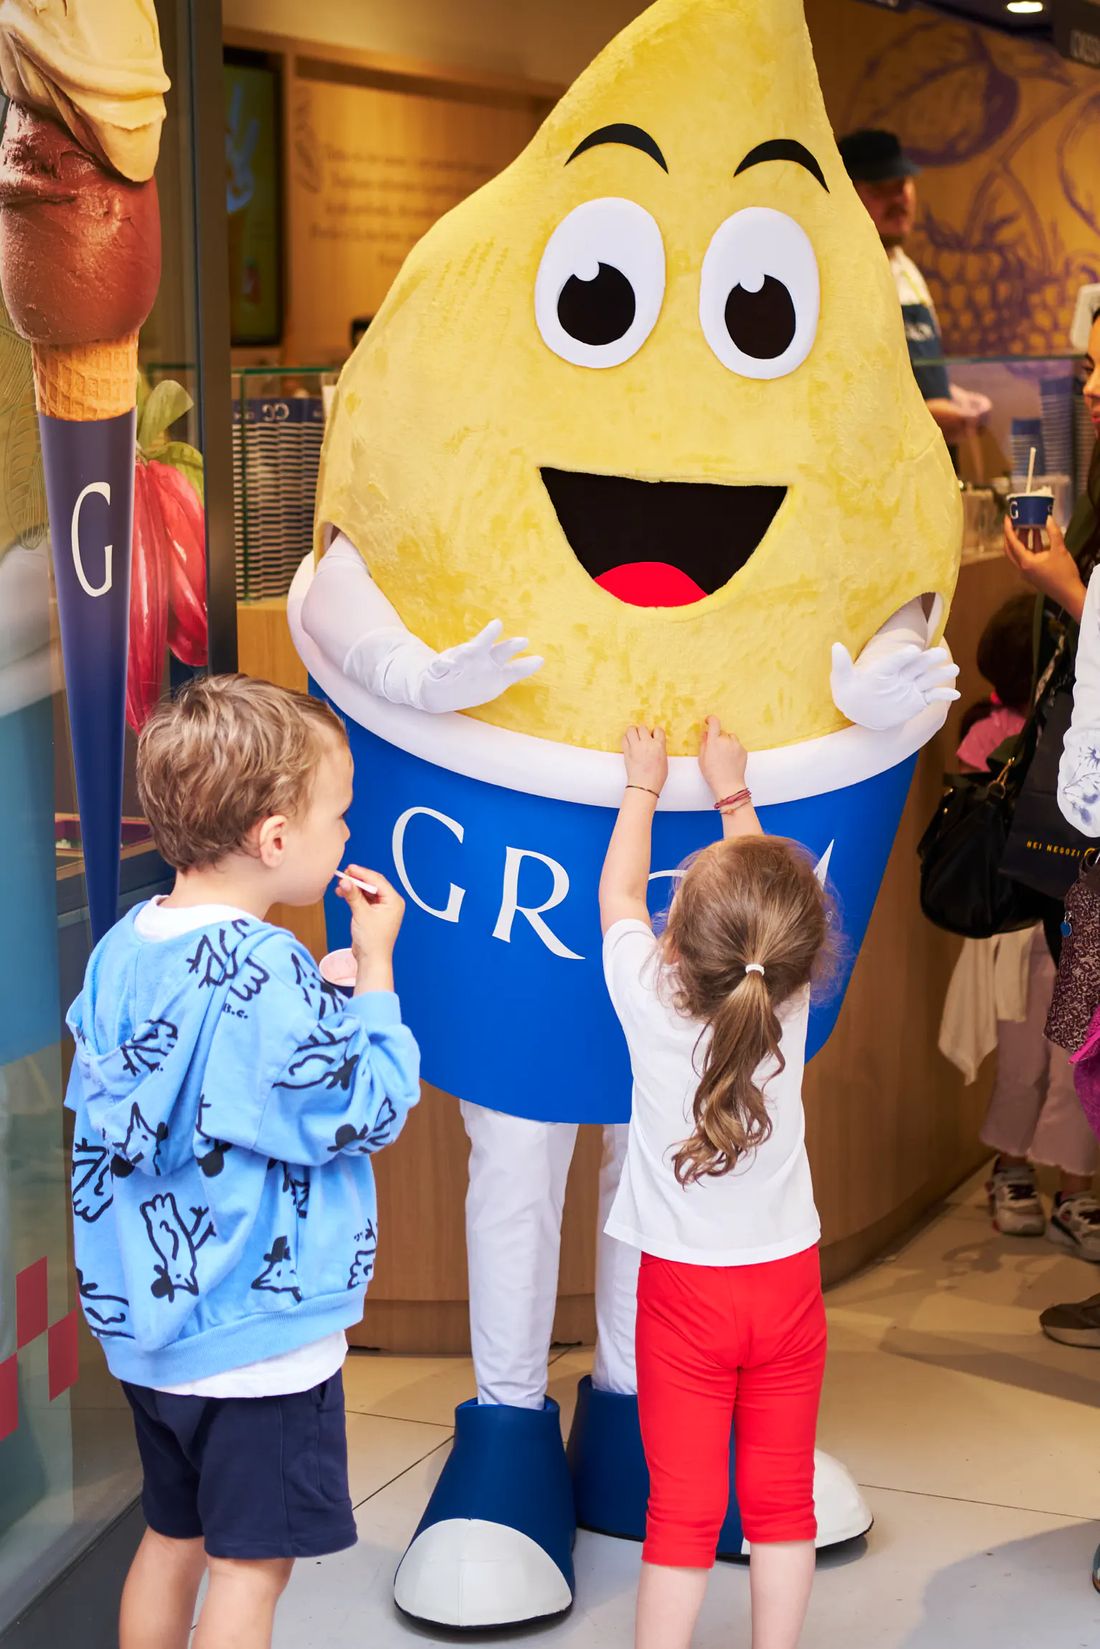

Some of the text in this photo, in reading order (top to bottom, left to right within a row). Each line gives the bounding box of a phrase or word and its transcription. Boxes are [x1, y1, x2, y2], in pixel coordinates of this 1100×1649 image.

[71, 481, 113, 597] G
[1010, 501, 1019, 519] G
[391, 806, 835, 960] GR
